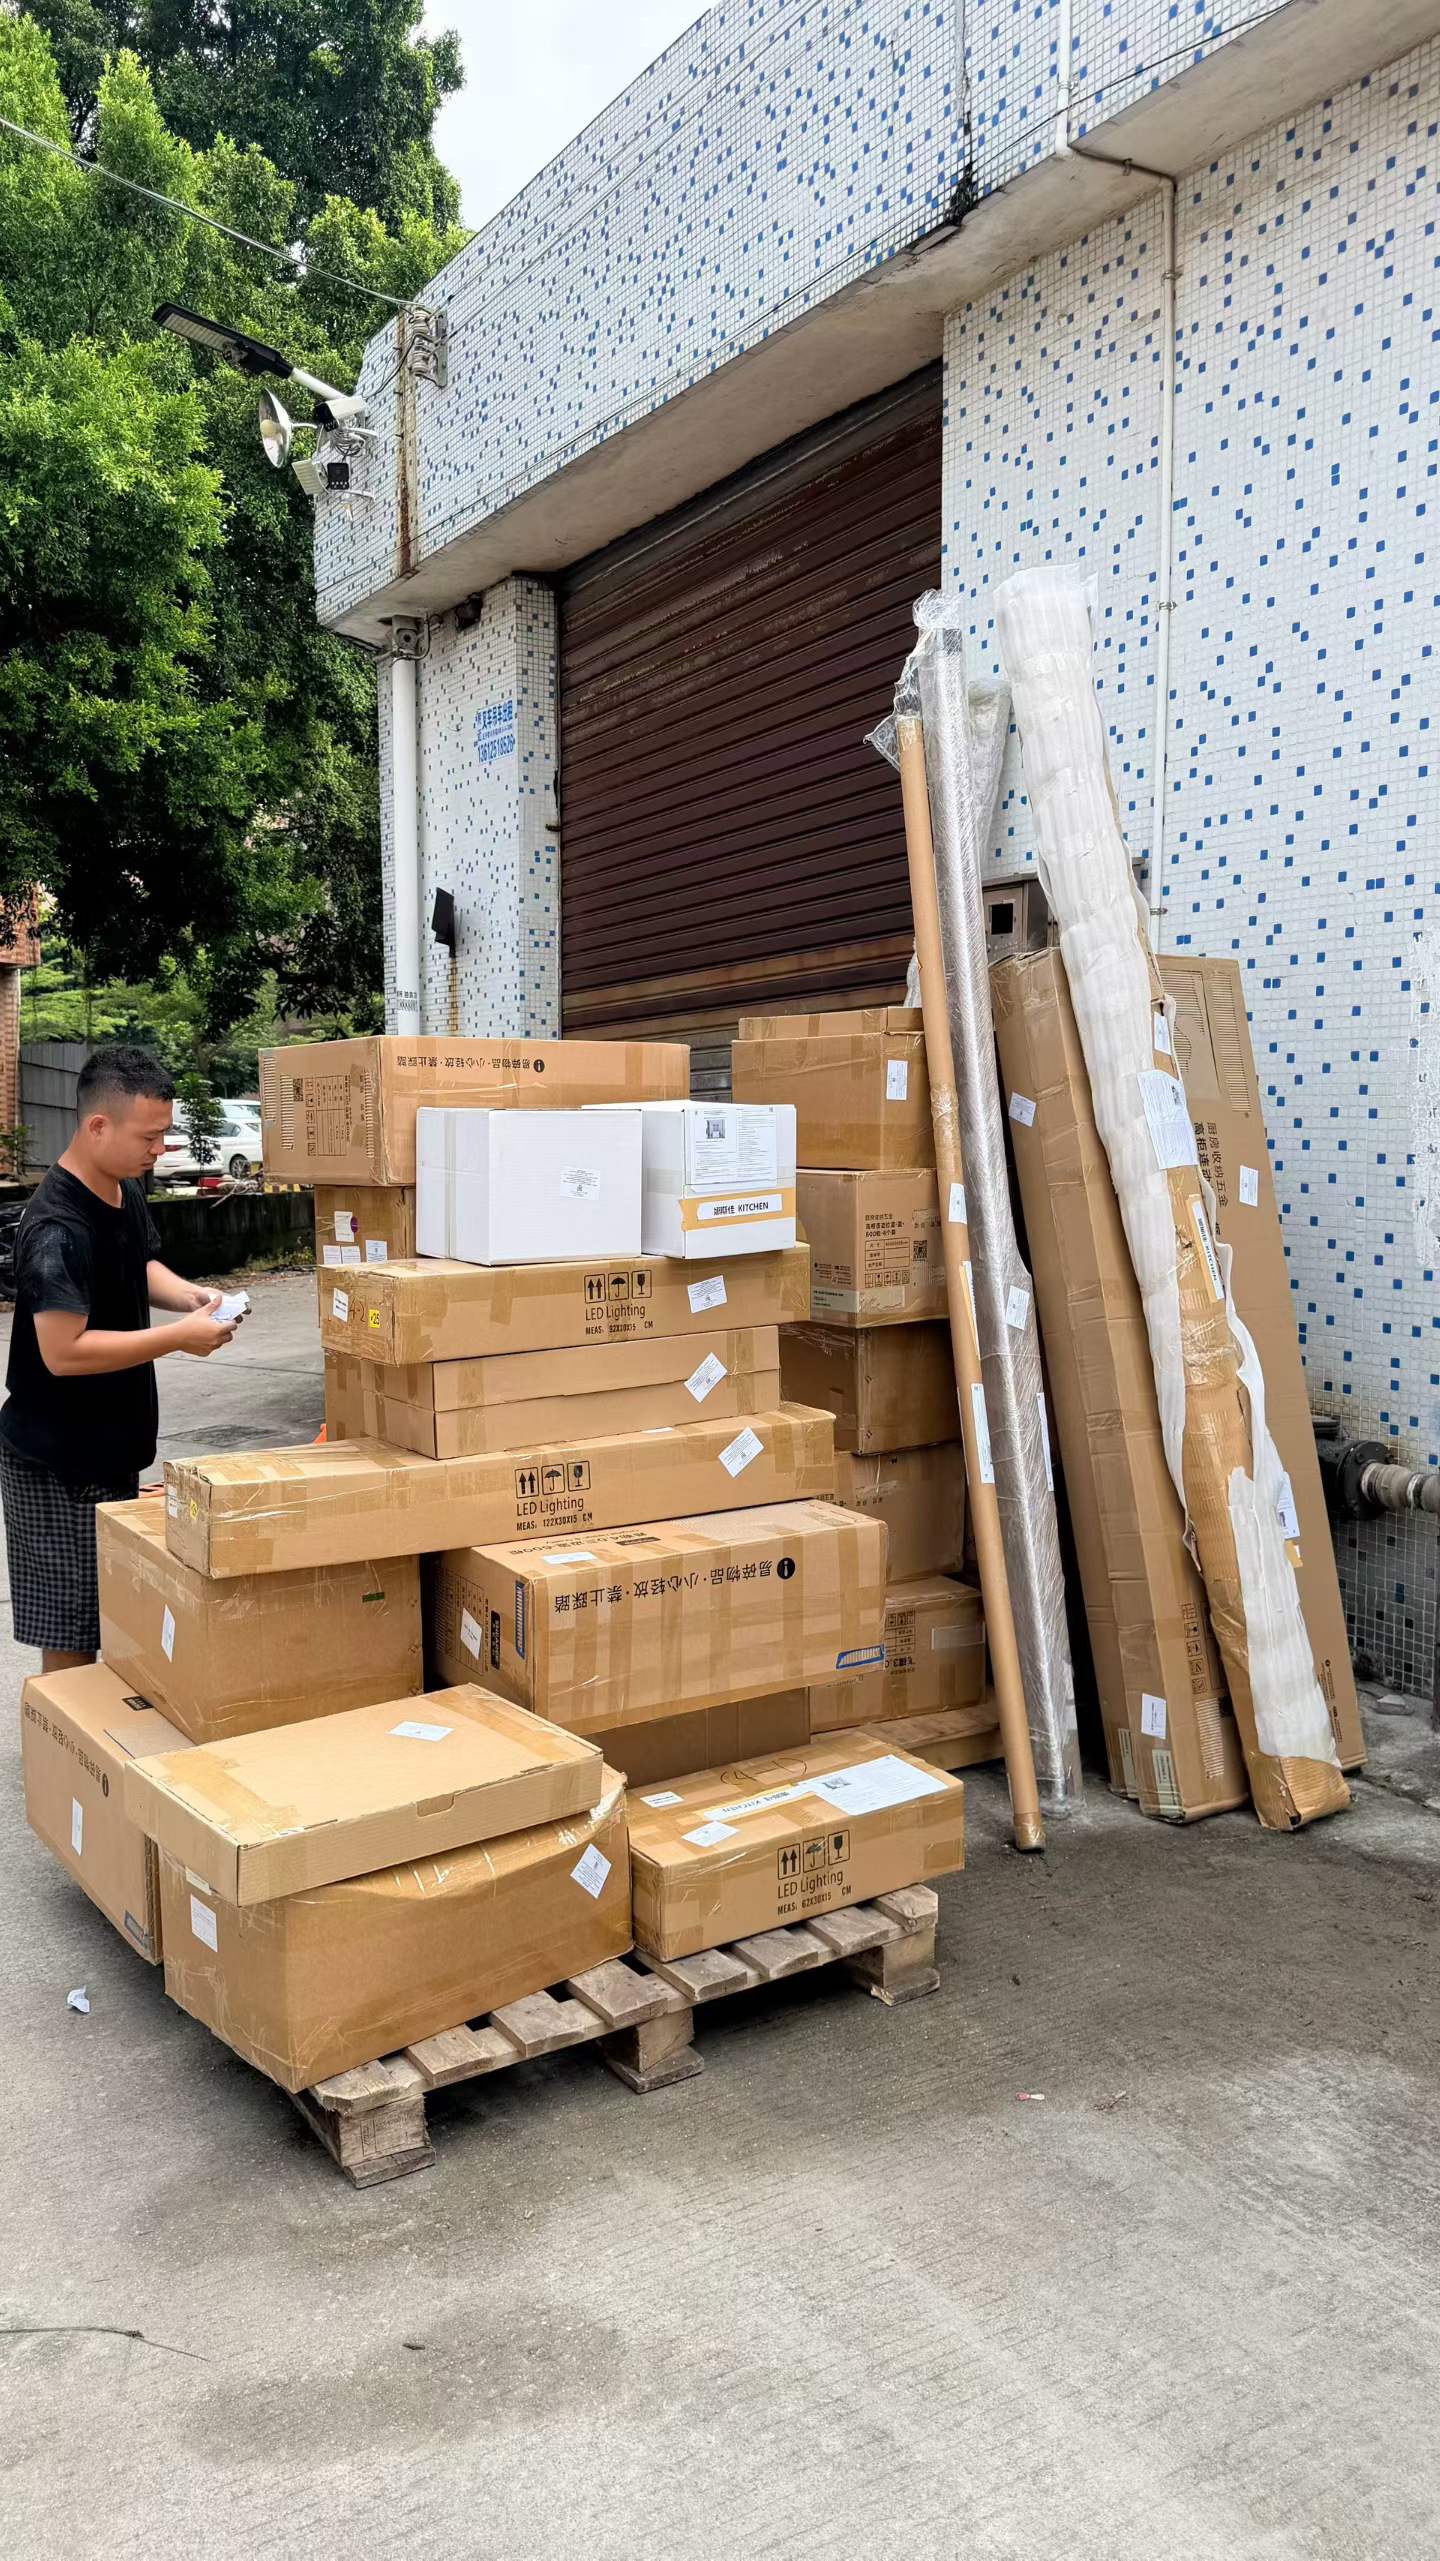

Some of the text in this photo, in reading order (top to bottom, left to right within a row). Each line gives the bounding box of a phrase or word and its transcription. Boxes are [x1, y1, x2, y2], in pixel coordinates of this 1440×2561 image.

[737, 1202, 769, 1213] KITCHEN
[585, 1303, 646, 1321] LED Lighting
[644, 1320, 654, 1329] CM
[516, 1496, 584, 1517] LED Lighting
[582, 1512, 593, 1522] CM
[777, 1869, 844, 1899] LED Lighting
[841, 1885, 852, 1897] CM
